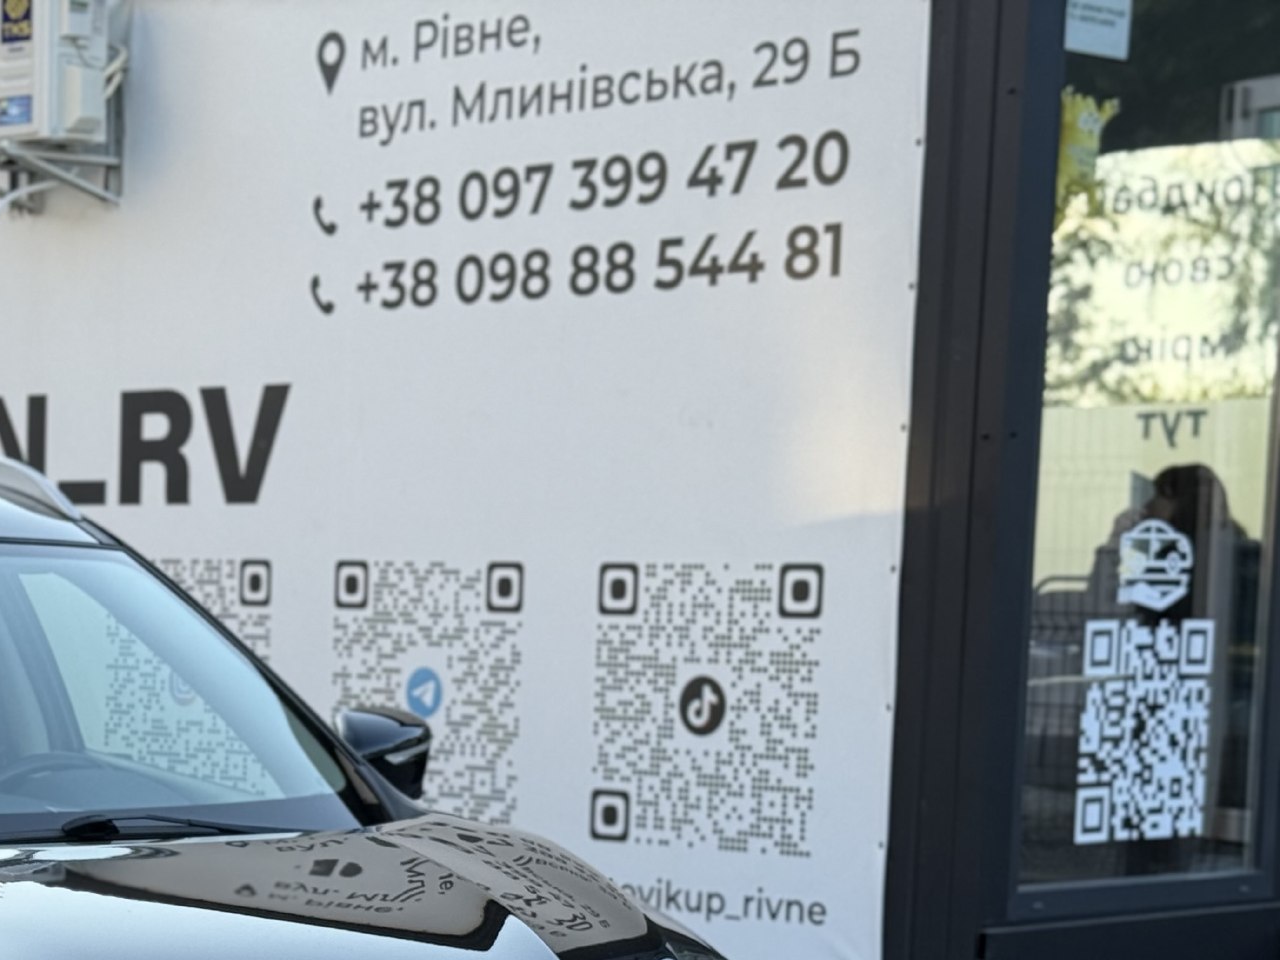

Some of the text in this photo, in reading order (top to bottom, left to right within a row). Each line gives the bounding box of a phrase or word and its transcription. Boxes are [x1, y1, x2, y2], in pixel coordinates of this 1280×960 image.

[358, 28, 862, 146] вул. Млинівська, 29 Б
[360, 13, 542, 70] м. Рівне,
[359, 129, 851, 228] +38 097 399 47 20
[356, 222, 843, 310] +38 098 88 544 81
